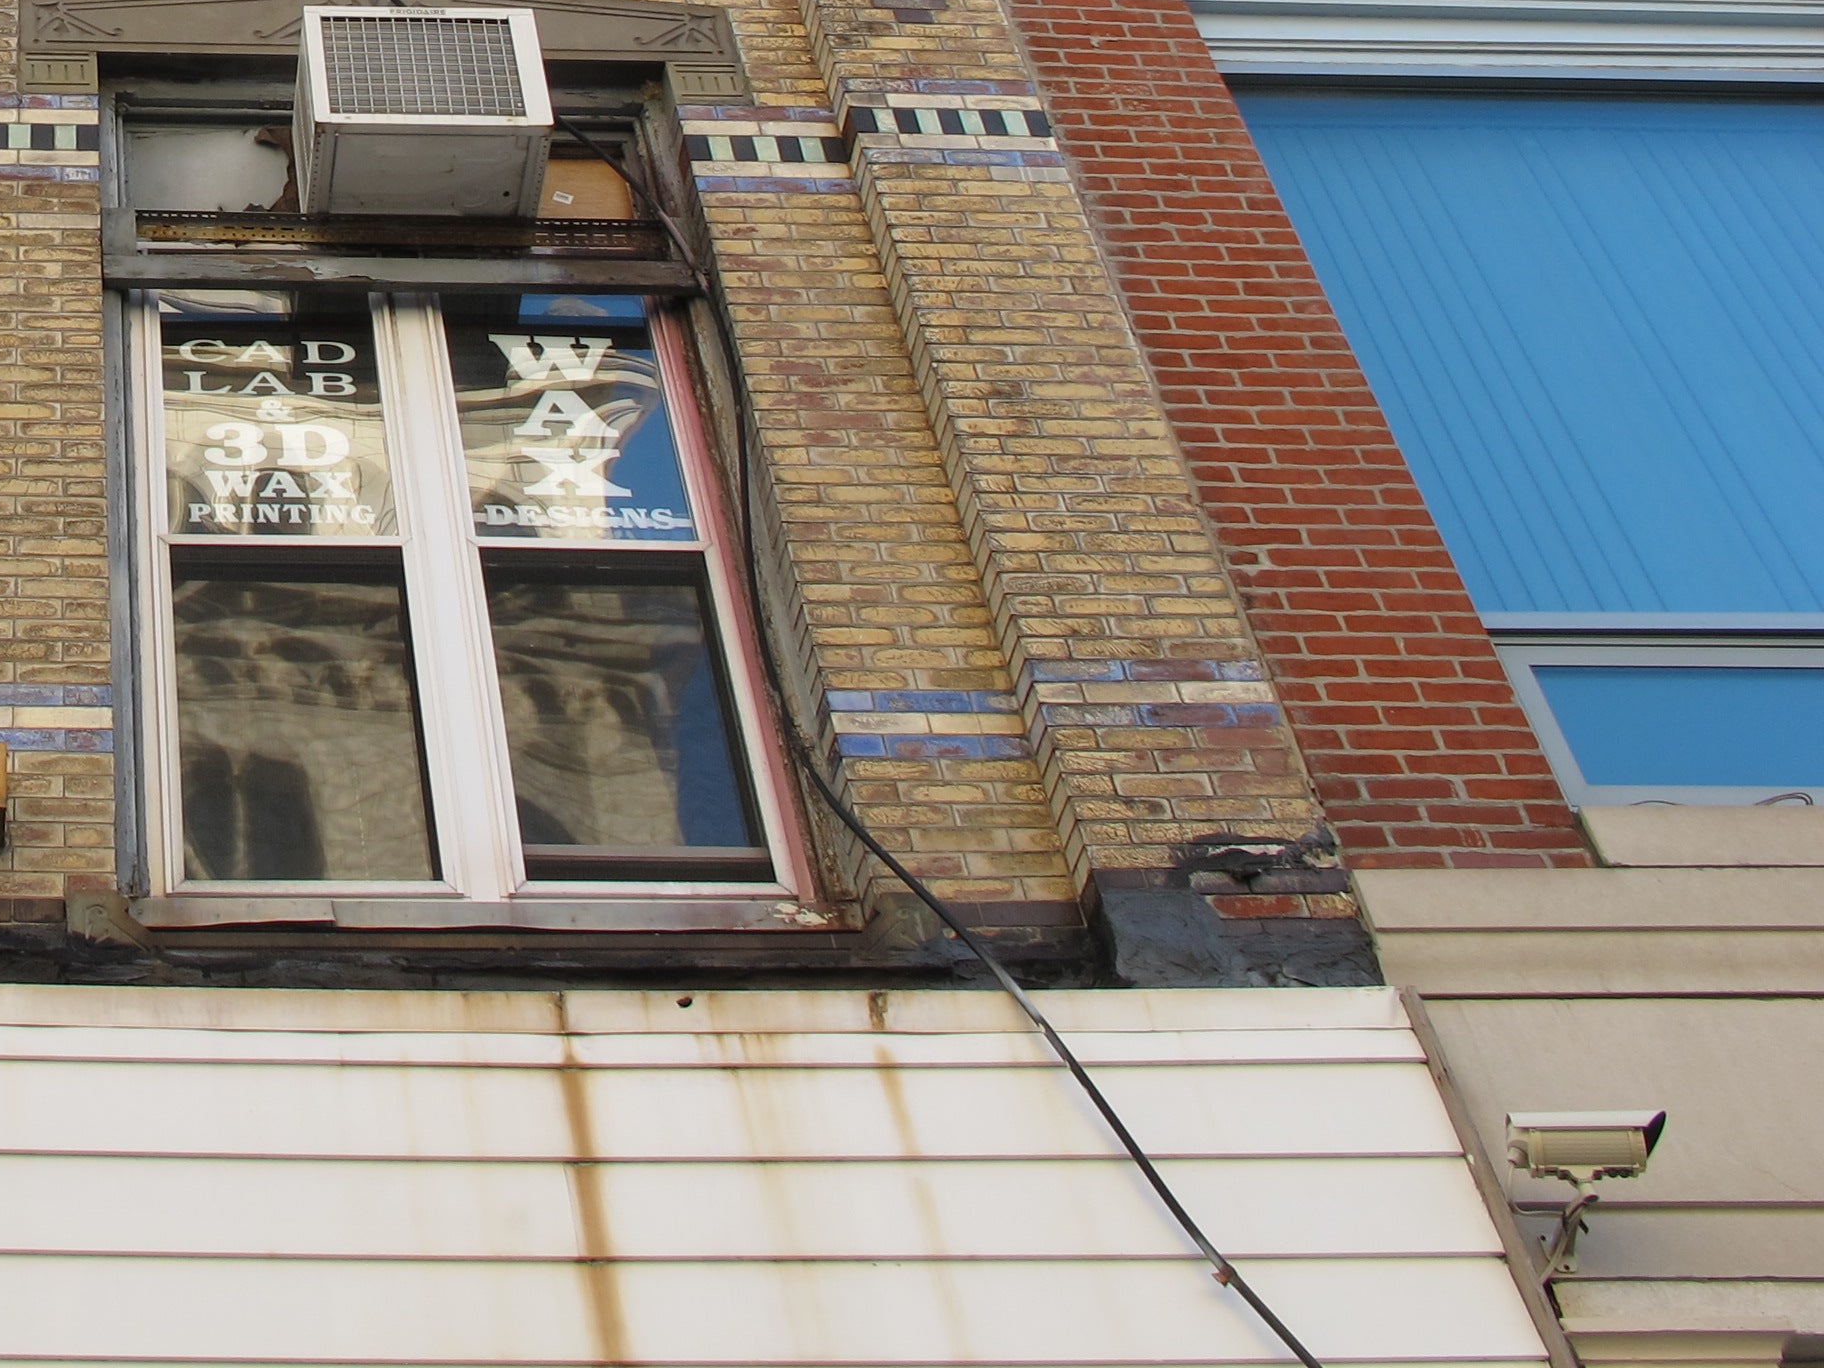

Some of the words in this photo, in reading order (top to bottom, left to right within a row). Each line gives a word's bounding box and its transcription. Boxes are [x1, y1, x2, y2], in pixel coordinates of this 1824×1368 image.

[179, 339, 357, 364] CAD
[183, 370, 358, 396] LAB
[256, 399, 296, 421] &
[487, 333, 632, 498] WAX
[204, 421, 350, 466] 3D
[204, 469, 355, 498] WAX
[188, 503, 376, 524] PRINTING
[483, 504, 676, 530] DESIGNS
